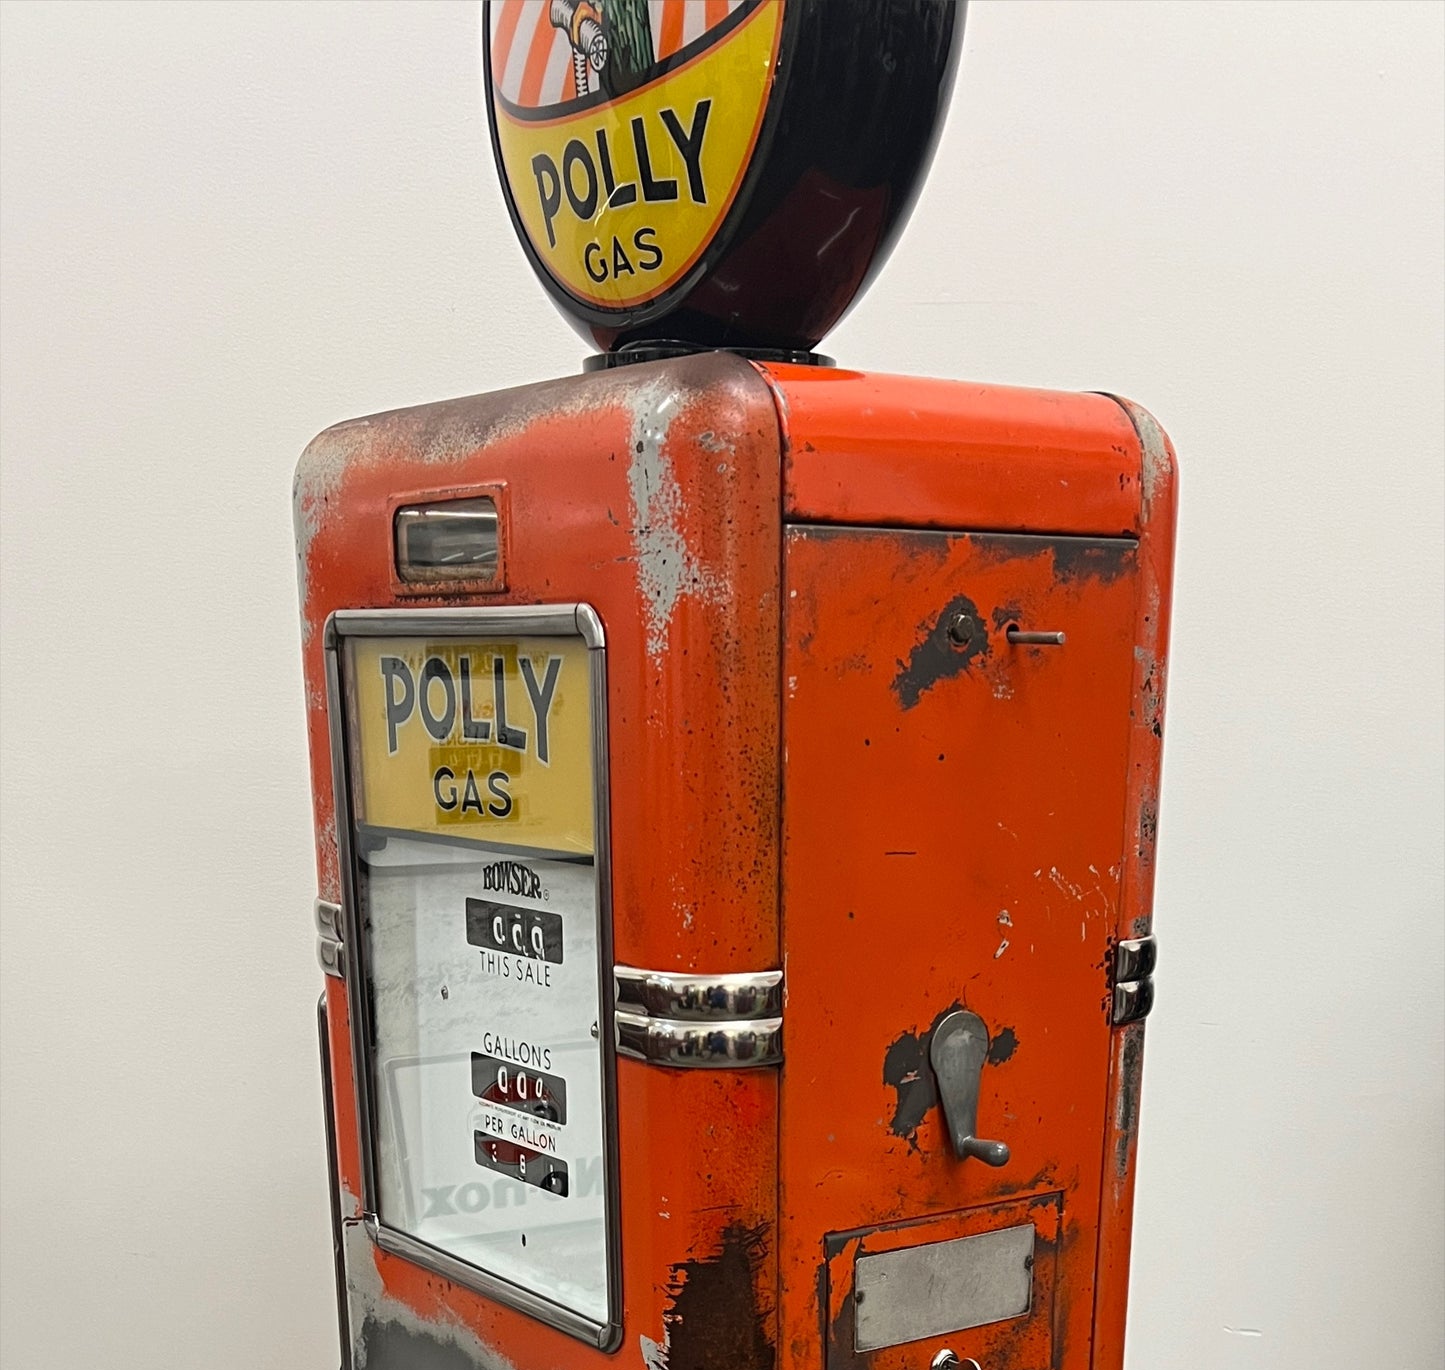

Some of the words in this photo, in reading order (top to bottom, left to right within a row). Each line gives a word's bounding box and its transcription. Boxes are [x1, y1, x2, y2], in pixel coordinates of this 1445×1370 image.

[531, 100, 711, 249] POLLY
[584, 228, 663, 283] GAS
[380, 656, 561, 764] POLLY
[434, 766, 512, 817] GAS
[483, 861, 542, 899] BOWSER
[480, 951, 510, 978] THIS
[516, 959, 551, 987] SALE
[483, 1032, 551, 1070] GALLONS
[485, 1115, 504, 1134] PER
[511, 1124, 556, 1152] GALLON
